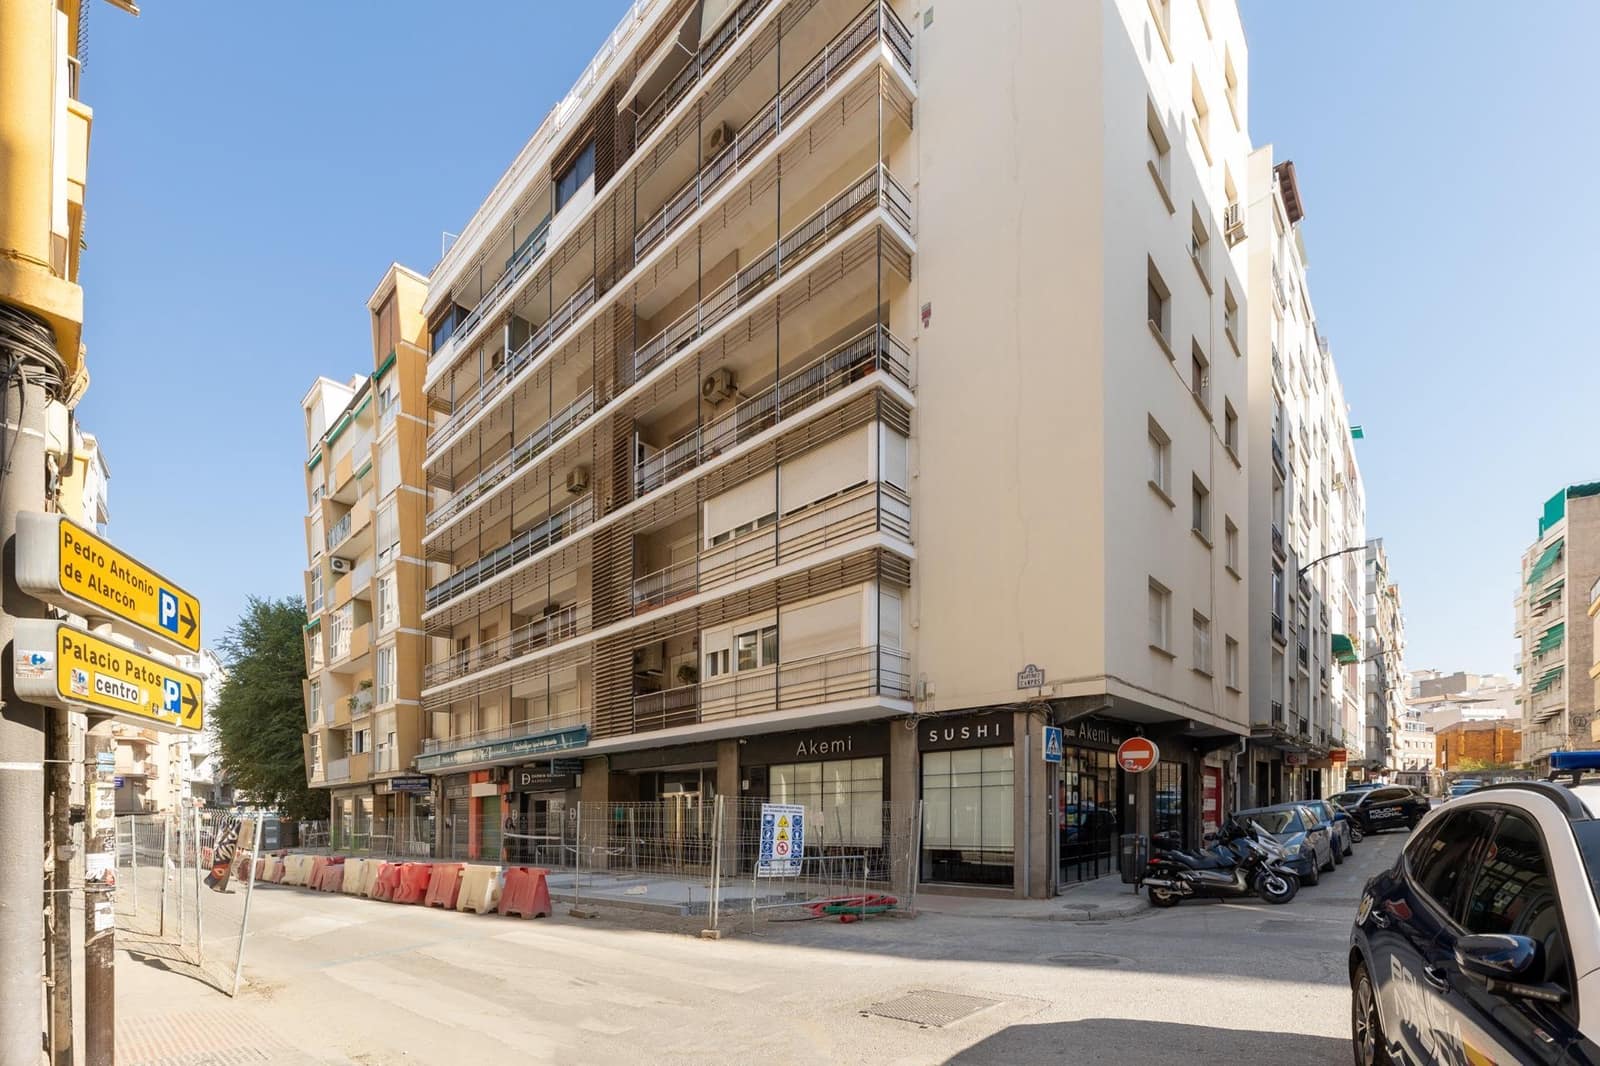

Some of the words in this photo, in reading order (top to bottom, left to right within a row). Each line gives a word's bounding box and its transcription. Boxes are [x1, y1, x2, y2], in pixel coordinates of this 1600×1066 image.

[63, 531, 105, 568] Pedro
[110, 560, 154, 597] Antonio
[64, 562, 82, 583] de
[88, 576, 136, 611] Alarcón
[161, 593, 177, 626] P
[62, 635, 120, 673] Palacio
[125, 664, 162, 687] Patos
[96, 677, 138, 702] centro
[166, 679, 180, 709] P
[796, 735, 852, 756] Akemi
[929, 723, 999, 742] SUSHI
[1079, 721, 1110, 743] Akemi
